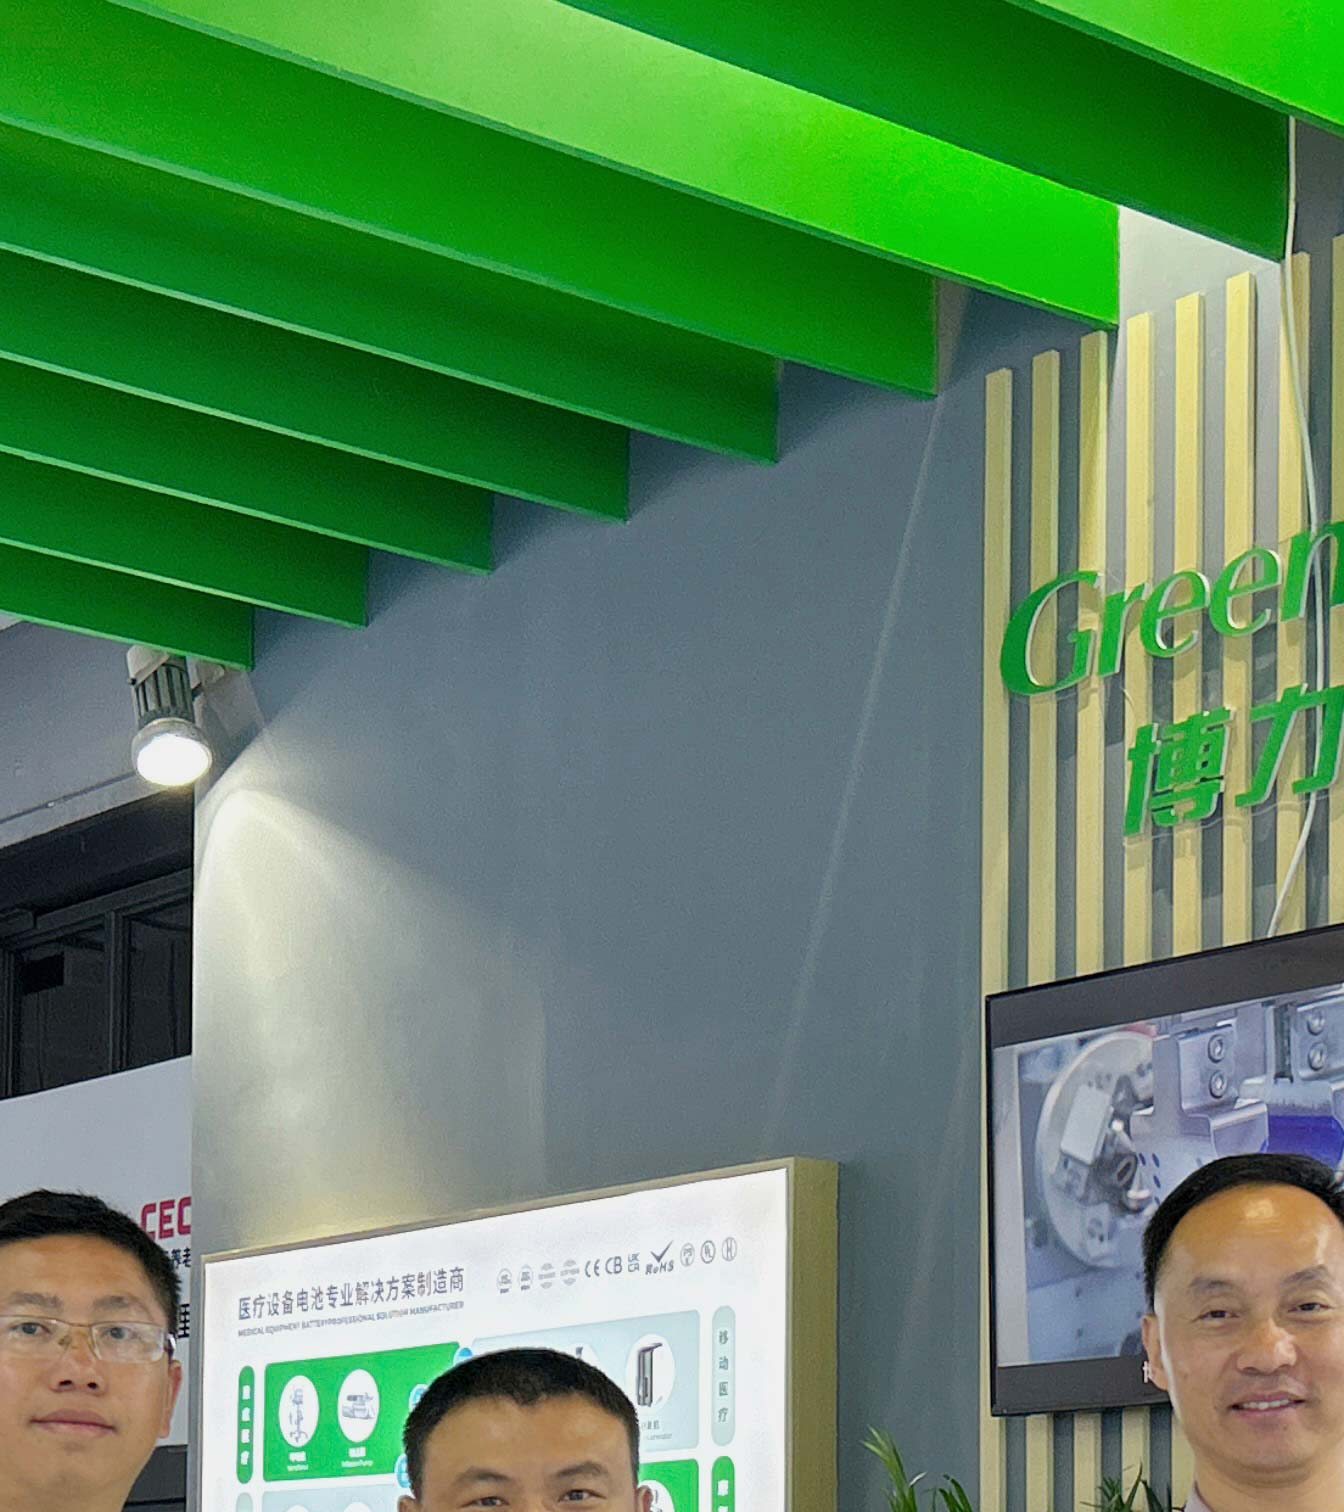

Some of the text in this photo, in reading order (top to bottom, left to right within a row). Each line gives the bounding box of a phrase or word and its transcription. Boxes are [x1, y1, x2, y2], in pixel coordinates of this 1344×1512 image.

[238, 1266, 465, 1321] 医疗设备电池专业解决方案制造商
